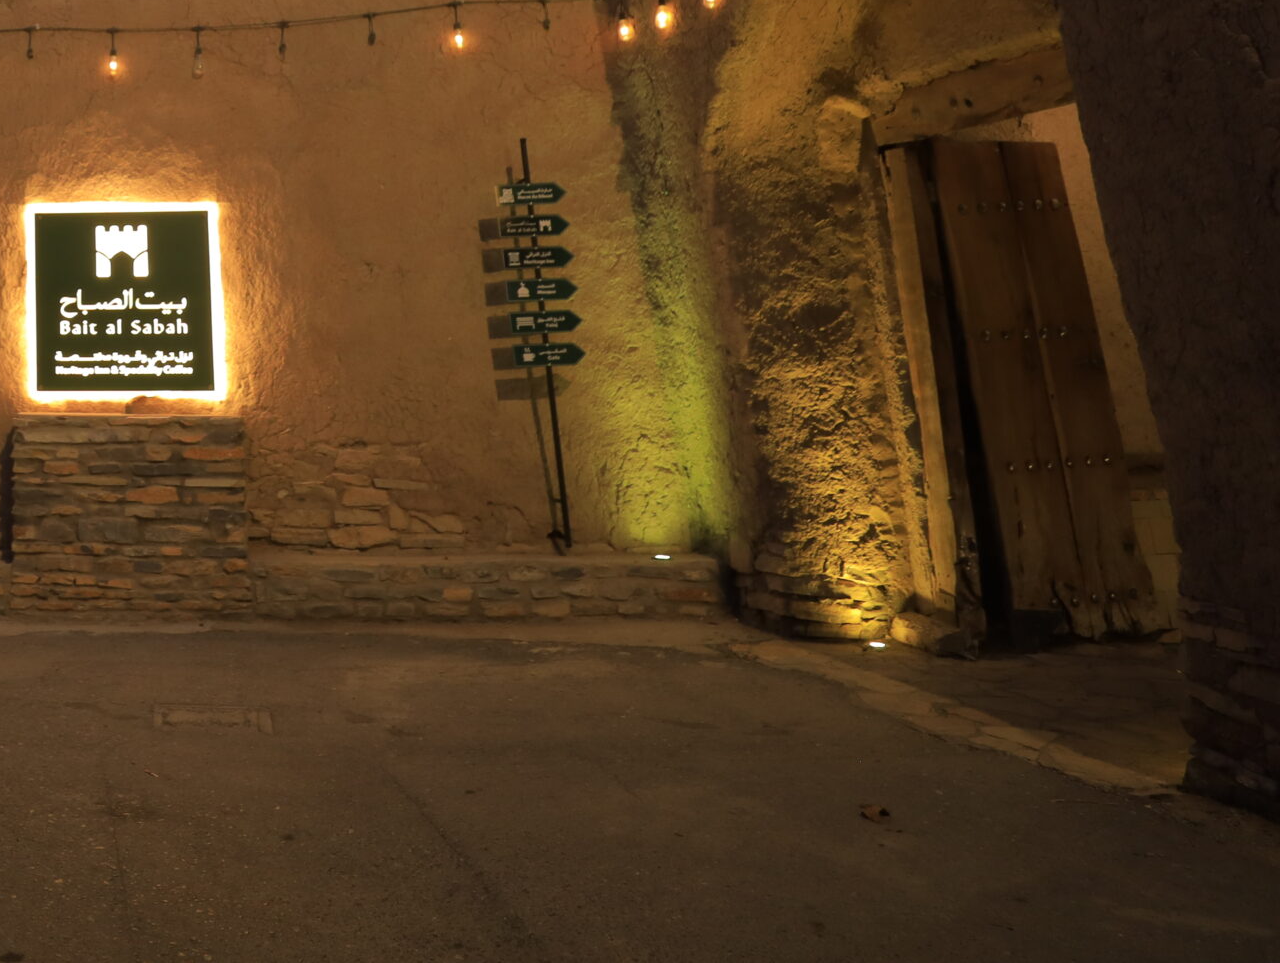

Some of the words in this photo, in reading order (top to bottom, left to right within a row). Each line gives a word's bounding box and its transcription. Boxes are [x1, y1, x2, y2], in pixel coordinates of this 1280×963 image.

[59, 287, 134, 319] الصباح
[135, 291, 188, 315] بيت
[59, 320, 98, 335] Bait
[105, 318, 122, 335] al
[130, 318, 189, 335] Sabah
[162, 364, 194, 375] Coffee
